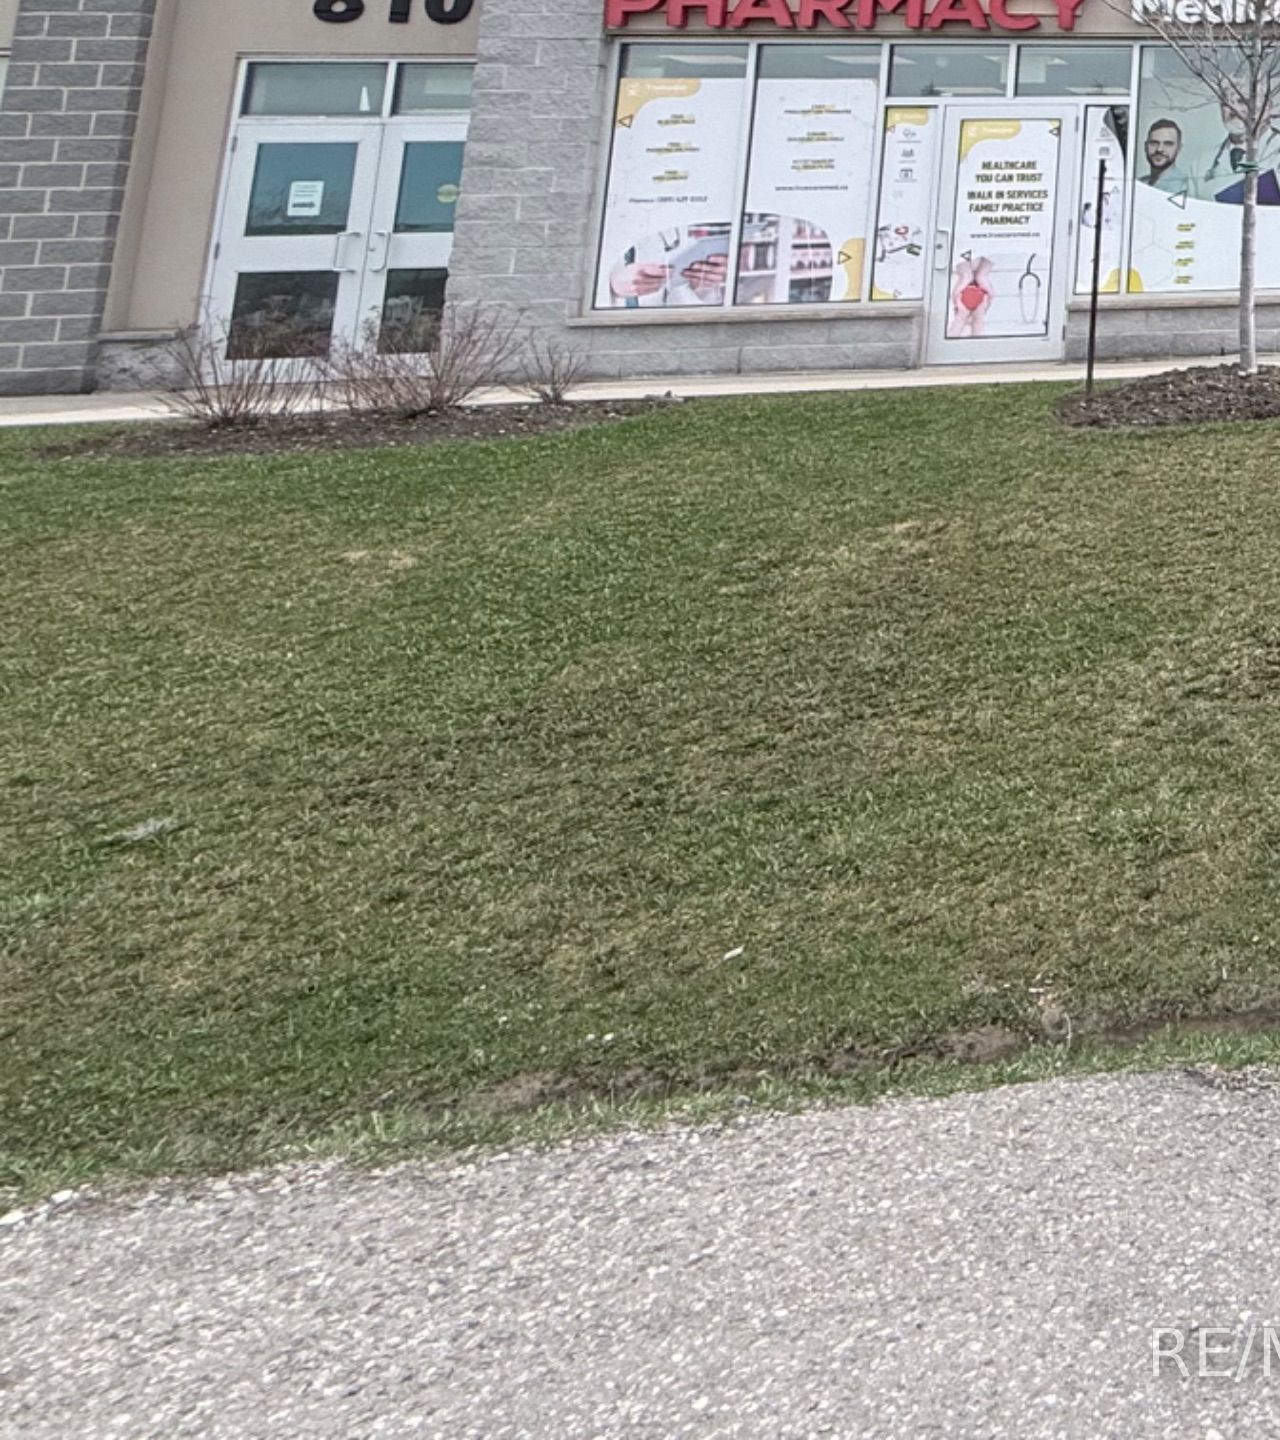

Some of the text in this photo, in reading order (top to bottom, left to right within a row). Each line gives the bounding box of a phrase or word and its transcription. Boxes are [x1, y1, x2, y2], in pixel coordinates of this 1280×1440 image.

[975, 173, 993, 183] YOU
[1016, 172, 1043, 182] TRUST
[1007, 189, 1049, 199] SERVICES
